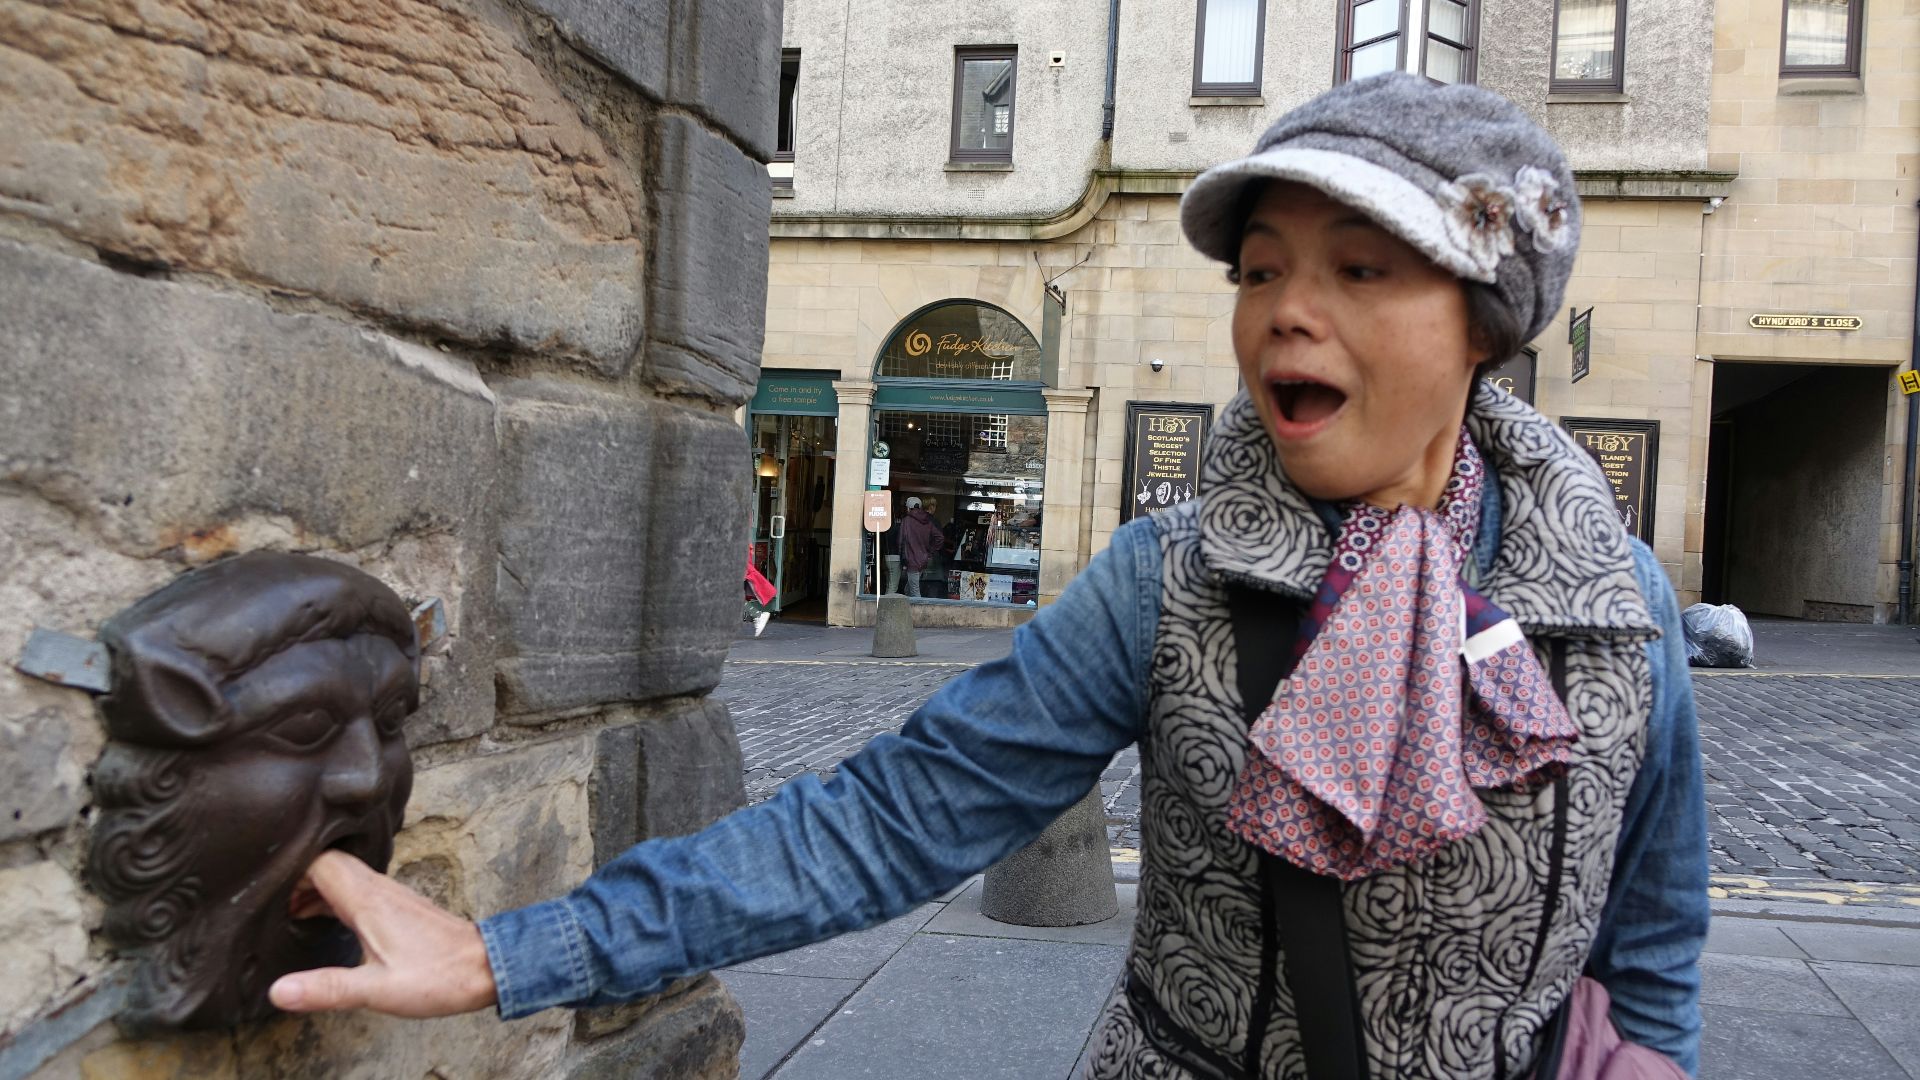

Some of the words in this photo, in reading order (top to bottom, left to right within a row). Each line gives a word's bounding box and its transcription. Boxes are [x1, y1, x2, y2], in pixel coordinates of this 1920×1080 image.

[1759, 317, 1818, 326] HYNDFORD'S
[1824, 318, 1855, 327] CLOSE
[936, 333, 971, 356] Fudge
[971, 334, 1024, 359] Kitchen
[768, 384, 789, 393] Come
[798, 386, 812, 394] and
[813, 386, 823, 395] try
[793, 396, 817, 405] sample
[1147, 434, 1190, 442] SCOTLAND'S
[1149, 449, 1187, 457] SELECTION
[1146, 471, 1187, 479] JEWELLERY
